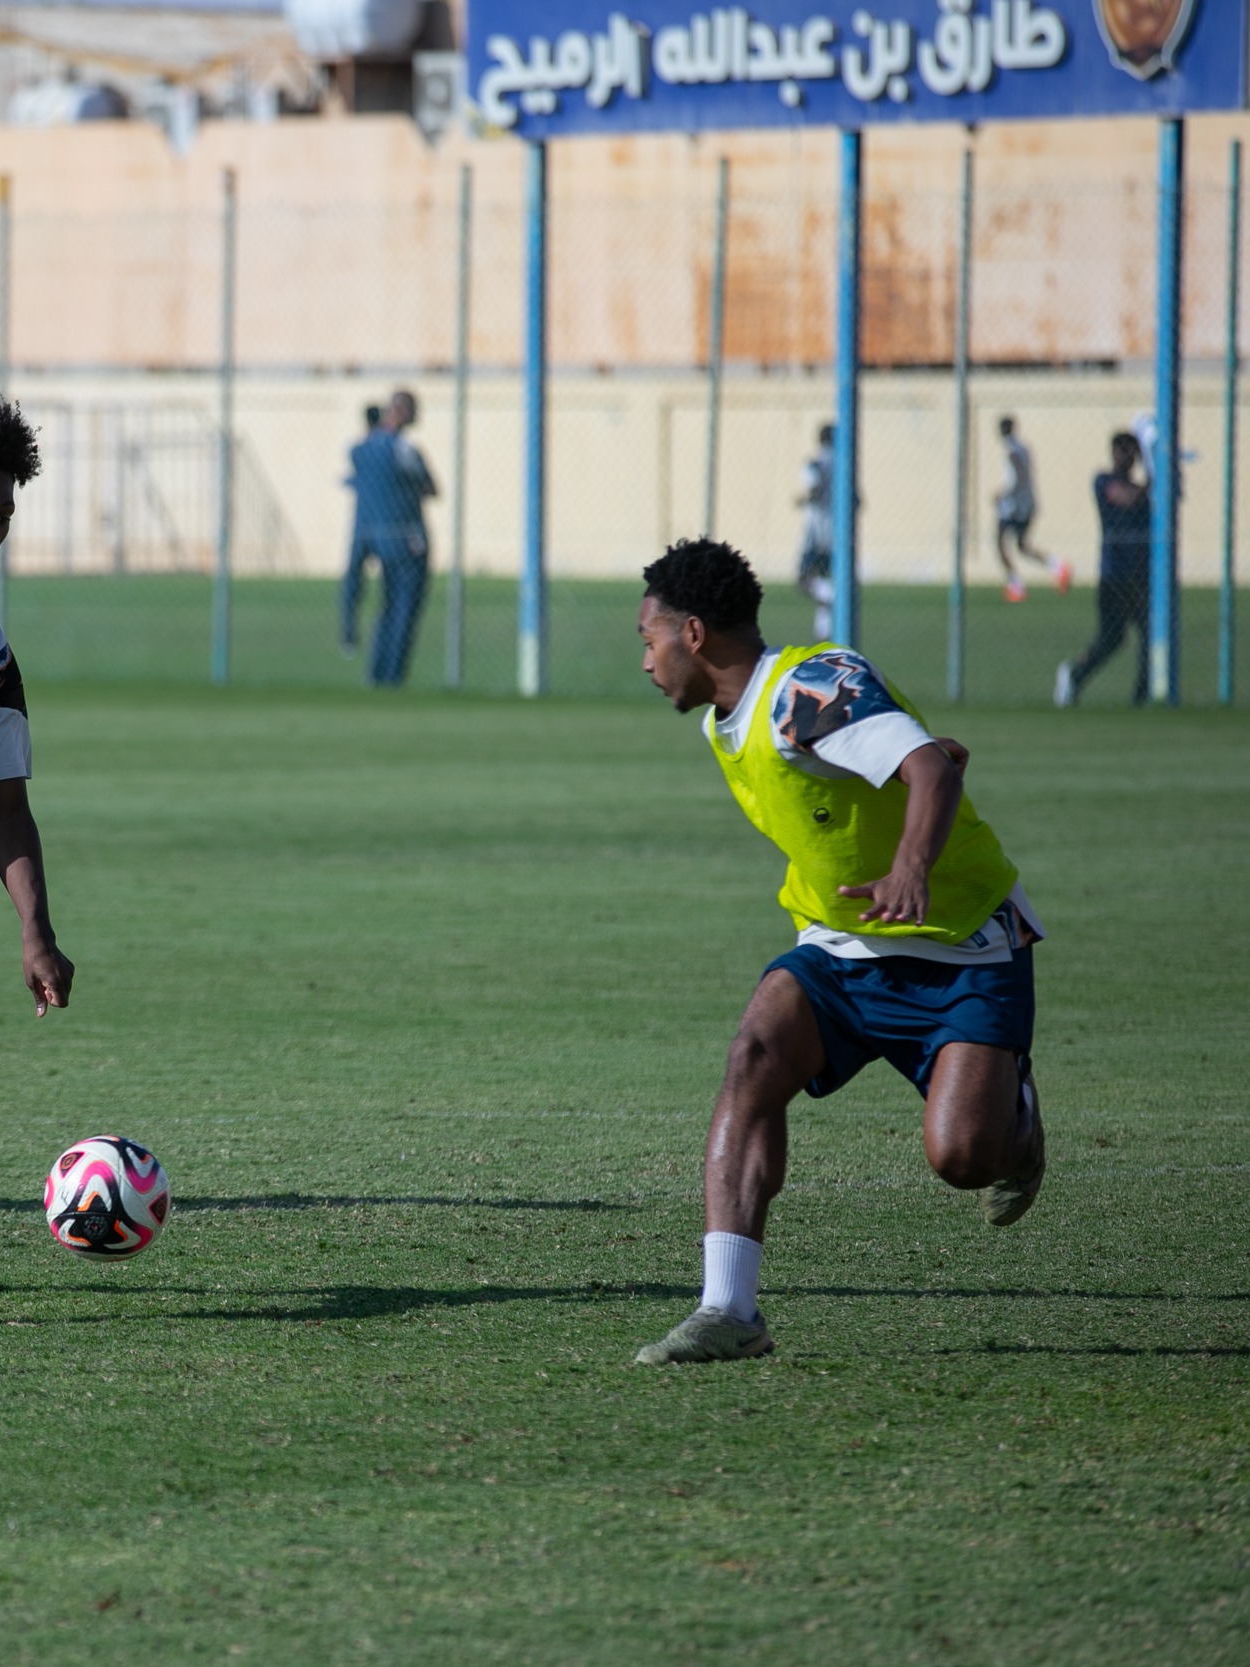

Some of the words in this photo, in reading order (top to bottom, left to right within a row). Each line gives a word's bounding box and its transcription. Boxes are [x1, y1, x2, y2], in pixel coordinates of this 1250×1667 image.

[478, 12, 643, 128] الرميح
[652, 6, 835, 107] عبدالله
[841, 8, 910, 103] بن
[917, 0, 1065, 95] طارق
